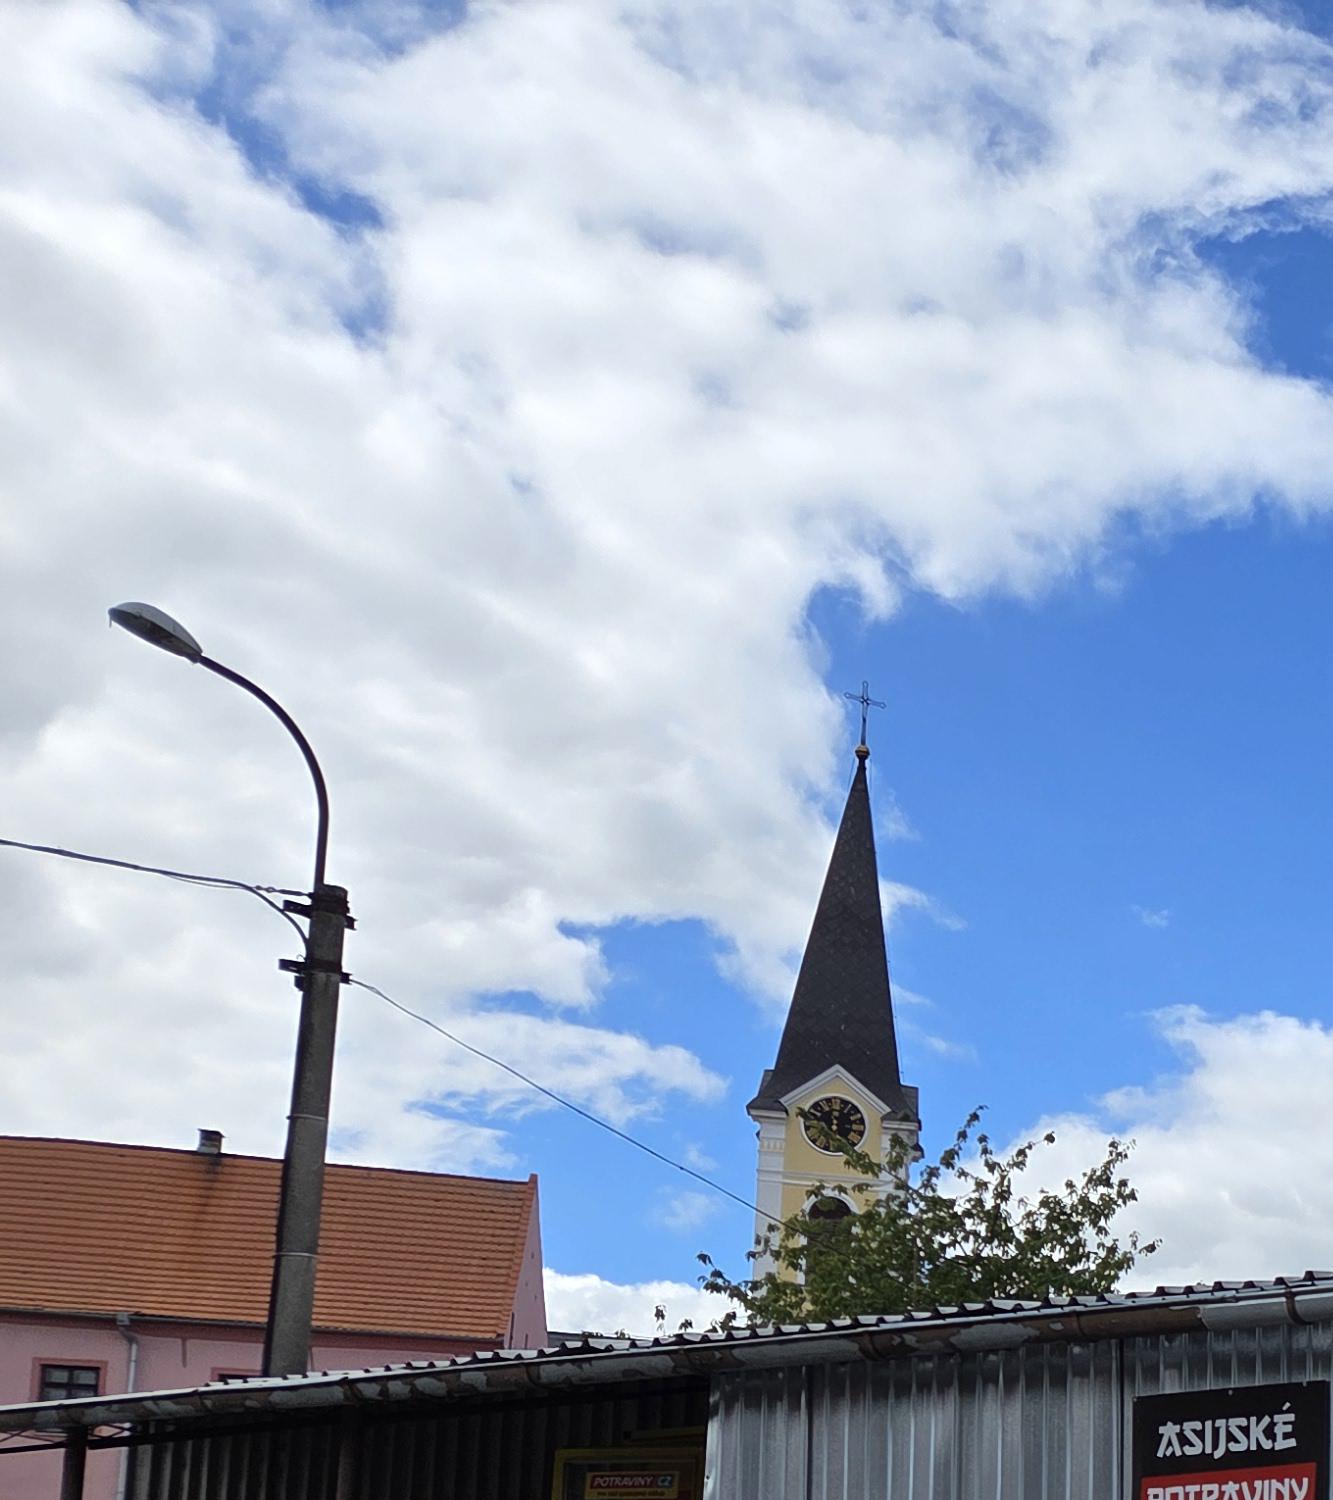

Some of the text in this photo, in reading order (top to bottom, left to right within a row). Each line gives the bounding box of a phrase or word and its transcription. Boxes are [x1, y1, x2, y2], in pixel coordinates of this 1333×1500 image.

[1156, 1402, 1297, 1461] ASIJSKÉ
[593, 1476, 672, 1487] POTRAVINY CZ
